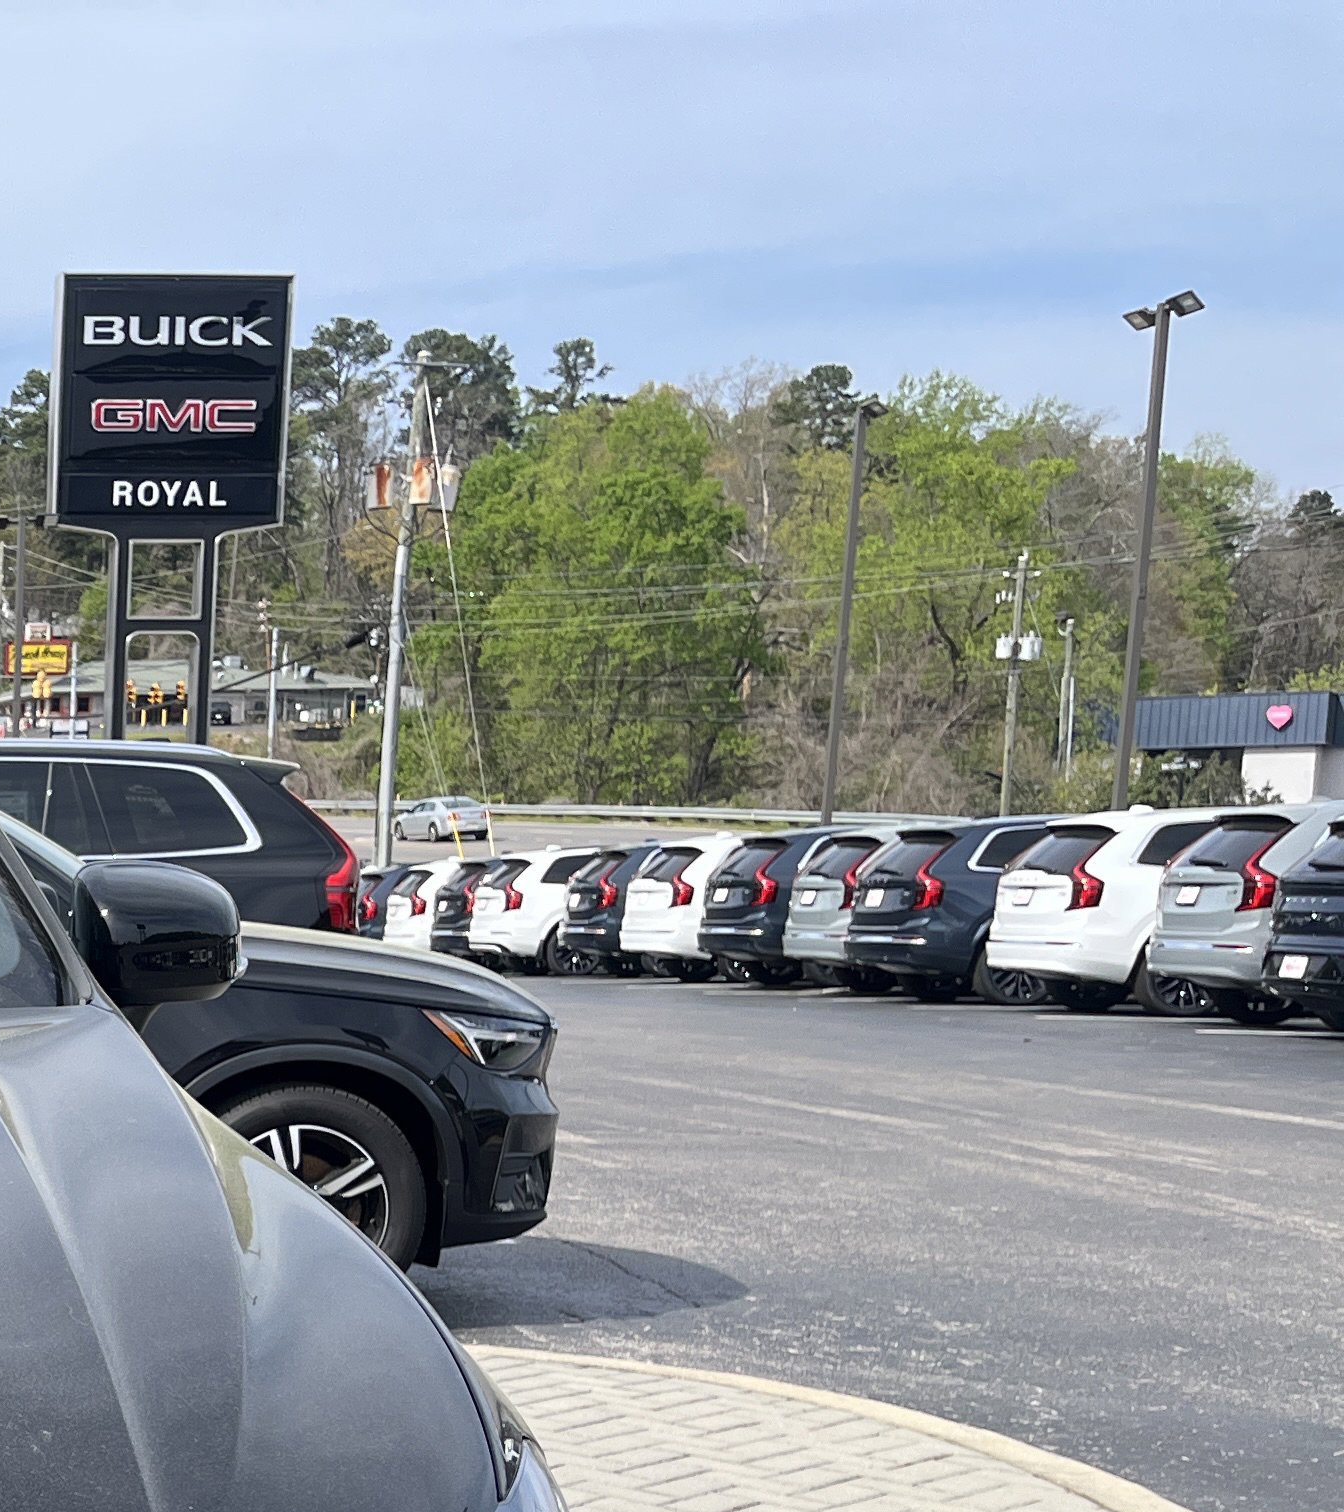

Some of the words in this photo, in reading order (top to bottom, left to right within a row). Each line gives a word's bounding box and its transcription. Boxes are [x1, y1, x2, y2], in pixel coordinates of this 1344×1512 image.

[81, 315, 274, 346] BUICK
[91, 398, 258, 433] GMC
[112, 480, 228, 507] ROYAL
